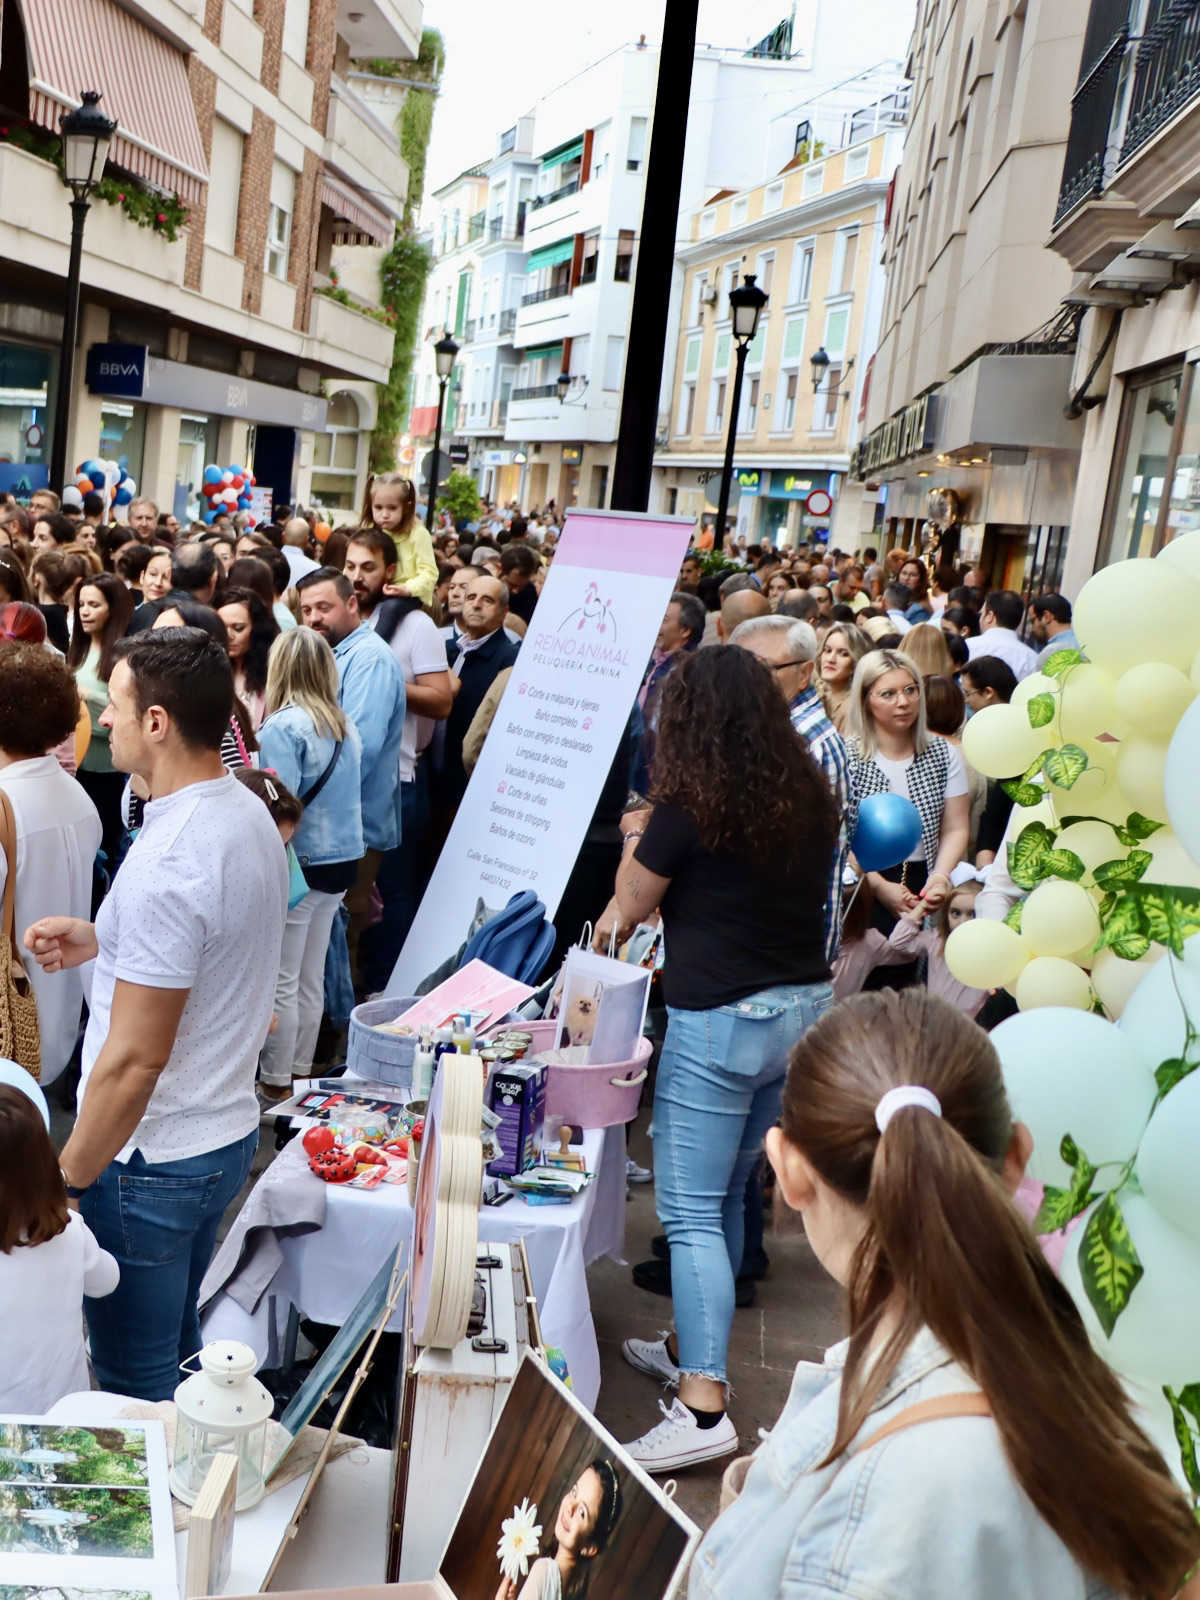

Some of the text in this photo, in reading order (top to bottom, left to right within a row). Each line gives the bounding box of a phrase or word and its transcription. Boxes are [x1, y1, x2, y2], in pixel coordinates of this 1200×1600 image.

[100, 363, 139, 376] BBVA
[226, 385, 248, 409] BBVA
[534, 633, 630, 667] REINO ANIMAL
[587, 664, 620, 679] CANINA
[528, 686, 545, 701] Corte
[574, 698, 582, 710] y
[534, 708, 578, 729] Baño completo
[506, 721, 524, 736] Baño
[523, 728, 535, 739] con
[516, 745, 542, 761] Limpieza
[541, 752, 551, 764] de
[505, 763, 528, 780] Vaciado
[527, 770, 536, 781] de
[507, 785, 524, 799] Corte
[523, 790, 532, 801] de
[489, 800, 551, 832] Sesiones de stripping
[489, 822, 536, 847] Baños de ozono
[467, 848, 482, 862] Calle
[481, 853, 494, 865] San
[493, 857, 521, 876] Francisco
[529, 870, 539, 881] 32
